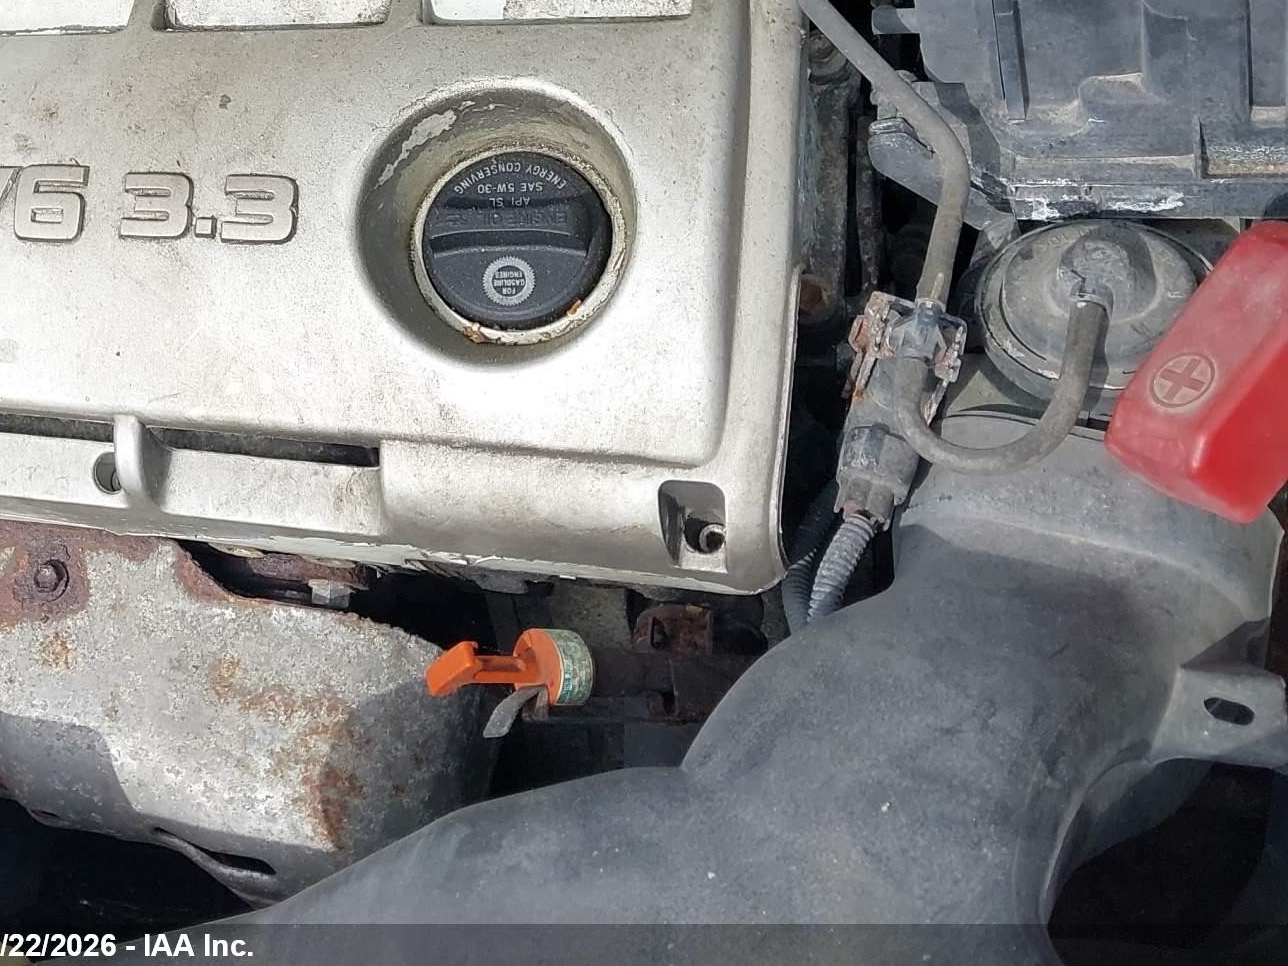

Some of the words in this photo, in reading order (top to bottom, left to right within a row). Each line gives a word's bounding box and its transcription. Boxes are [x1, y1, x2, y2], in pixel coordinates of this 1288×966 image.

[453, 161, 521, 195] CONSERVING
[525, 164, 568, 191] ENERGY
[477, 182, 515, 194] 5W-30
[520, 181, 544, 193] SAE
[489, 197, 504, 208] SL
[511, 196, 531, 207] API
[118, 172, 299, 245] 3.3
[493, 278, 526, 287] GASOLINE
[502, 287, 516, 295] FOR
